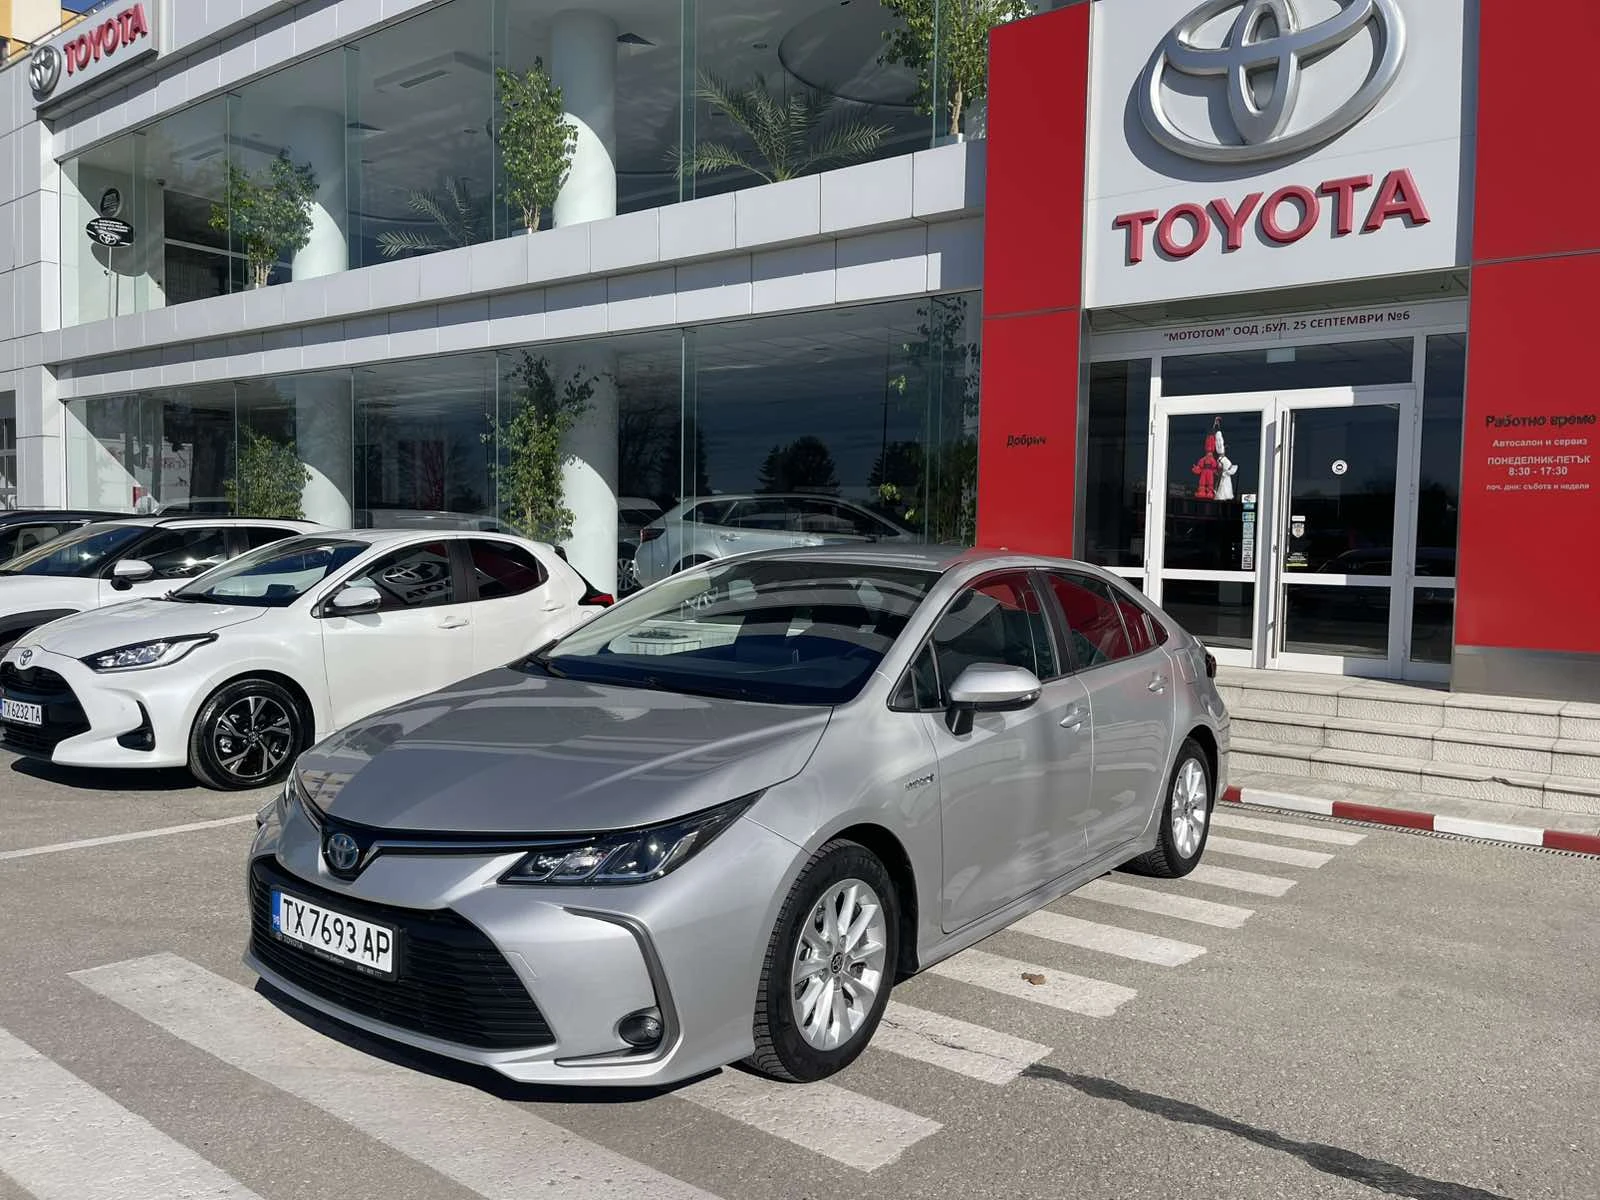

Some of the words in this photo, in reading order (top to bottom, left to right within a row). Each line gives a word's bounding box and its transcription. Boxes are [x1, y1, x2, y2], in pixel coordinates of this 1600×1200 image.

[63, 2, 148, 77] TOYOTA
[1114, 167, 1431, 264] TOYOTA
[1164, 327, 1231, 341] "МОТОТОМ"
[1233, 324, 1259, 336] ООД
[1293, 320, 1307, 330] 25
[1310, 312, 1384, 328] СЕПТЕМВРИ
[1485, 414, 1546, 428] Работно
[1553, 439, 1588, 447] сервиз
[1487, 455, 1591, 465] ПОНЕДЕЛНИК-ПЕТЪК
[1508, 467, 1530, 476] 8:30
[1540, 466, 1568, 476] 17:30
[308, 907, 357, 954] 7693
[363, 927, 390, 963] AP
